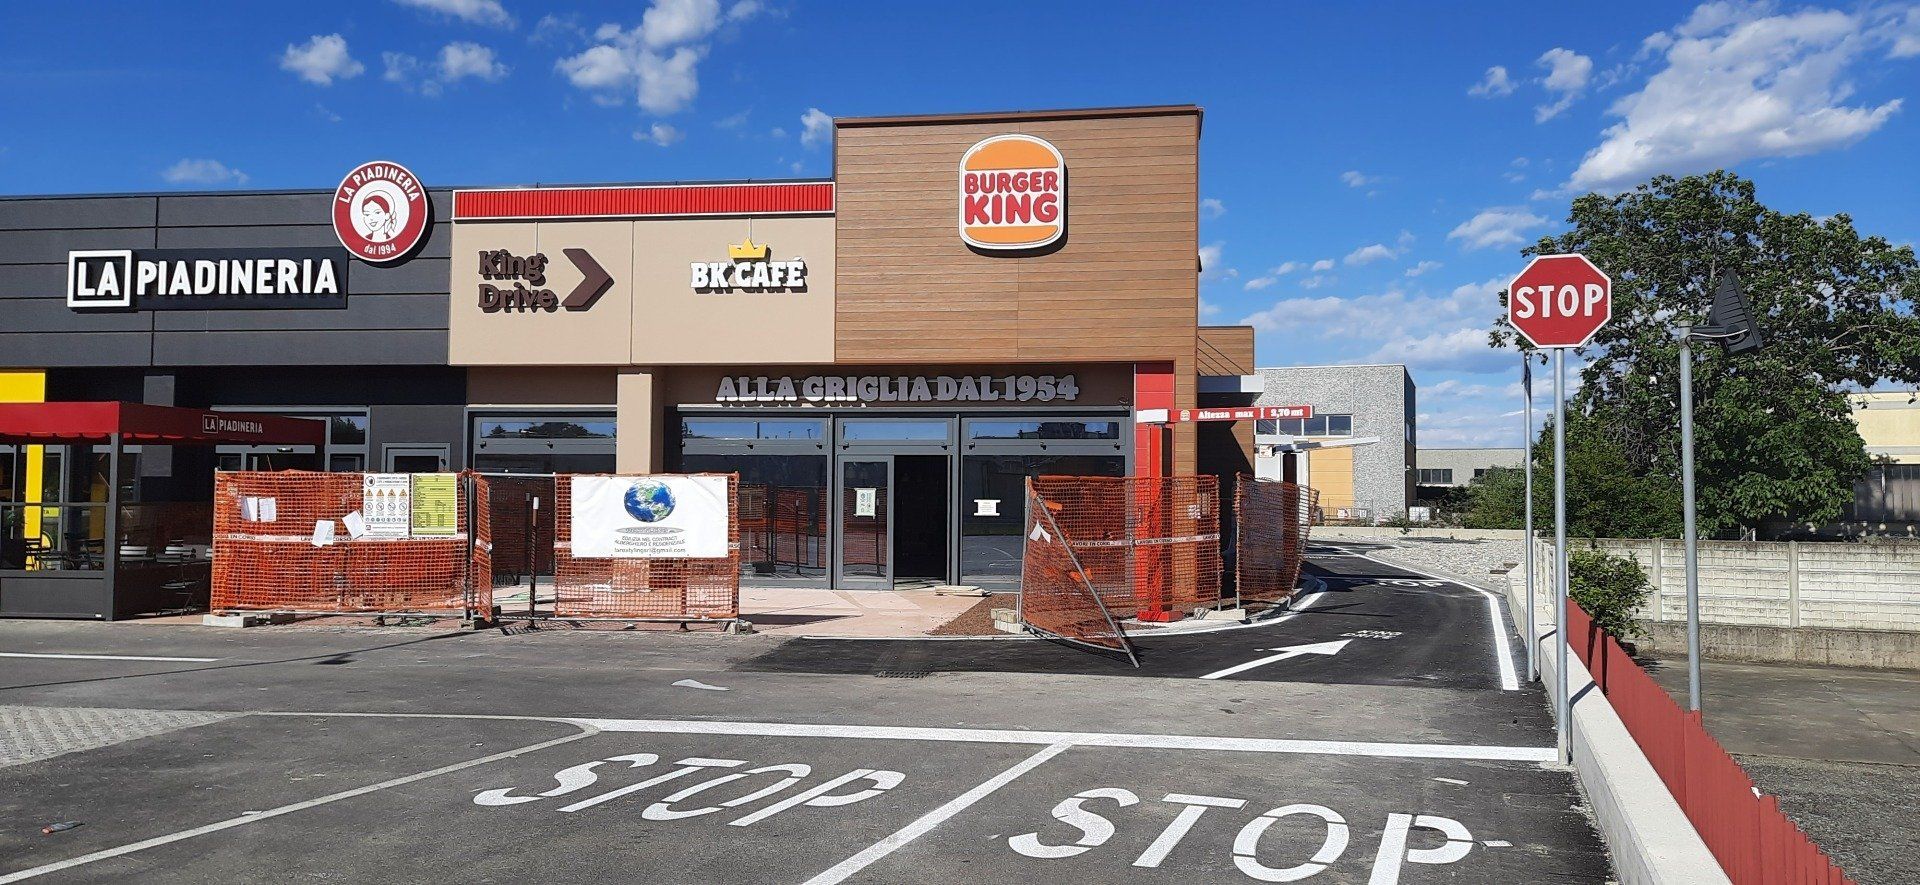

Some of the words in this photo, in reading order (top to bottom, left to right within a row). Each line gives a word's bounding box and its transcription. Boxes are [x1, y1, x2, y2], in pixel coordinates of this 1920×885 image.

[338, 186, 356, 204] LA
[352, 165, 421, 202] PIADINERIA
[964, 170, 1059, 195] BURGER
[964, 192, 1059, 225] KING
[363, 243, 376, 255] dal
[378, 242, 397, 256] 1994
[76, 261, 120, 296] LA
[136, 258, 339, 296] PIADINERIA
[478, 249, 546, 283] King
[690, 262, 729, 289] BK
[734, 256, 805, 289] CAFÉ
[478, 282, 557, 310] Drive
[1515, 283, 1605, 319] STOP
[715, 376, 797, 402] ALLA
[802, 375, 934, 402] GRIGLIA
[936, 375, 999, 401] DAL
[1003, 374, 1079, 402] 1954
[204, 418, 216, 430] LA
[219, 419, 264, 434] PIADINERIA
[1197, 410, 1231, 420] Altezza
[1234, 410, 1255, 418] max
[472, 752, 907, 827] STOP
[1008, 787, 1473, 885] STOP
